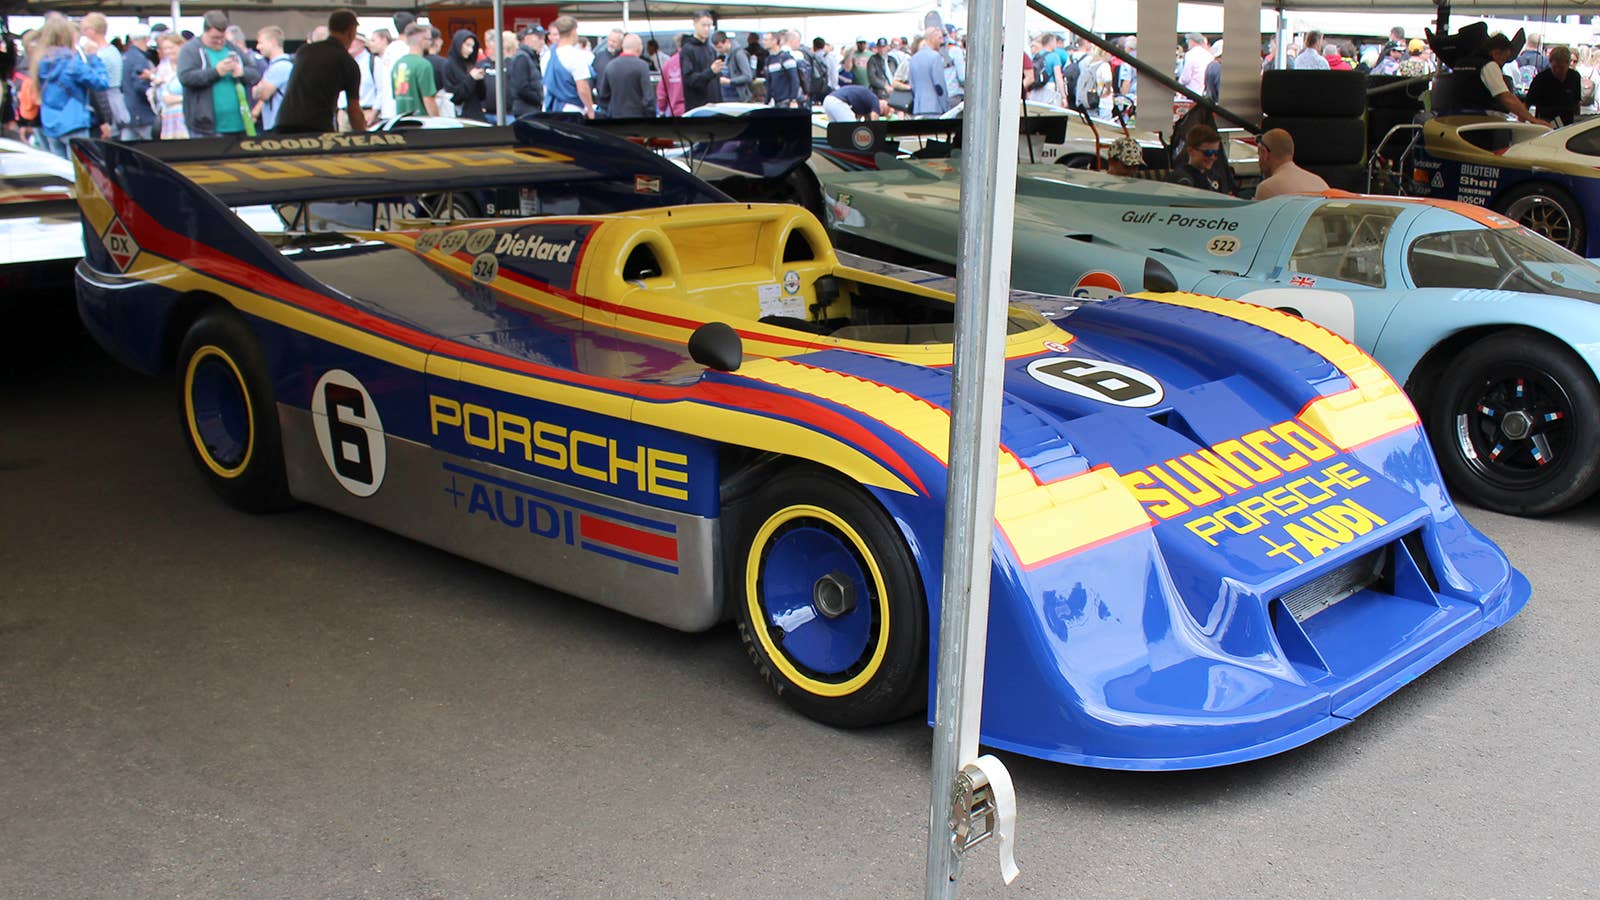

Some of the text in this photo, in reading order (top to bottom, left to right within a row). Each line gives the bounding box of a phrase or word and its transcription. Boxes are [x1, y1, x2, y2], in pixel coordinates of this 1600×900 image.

[1459, 176, 1498, 189] Shell
[1460, 164, 1500, 179] BILSTEIN
[1457, 195, 1485, 206] BOSCH
[1121, 211, 1155, 224] Gulf
[1167, 214, 1239, 231] Porsche
[111, 236, 129, 253] DX
[494, 232, 576, 264] DieHard
[1210, 239, 1236, 253] 522
[1036, 360, 1156, 401] 6
[324, 382, 374, 485] 6
[429, 394, 688, 501] PORSCHE
[1120, 419, 1338, 521] SUNOCO
[1184, 461, 1371, 547] PORSCHE
